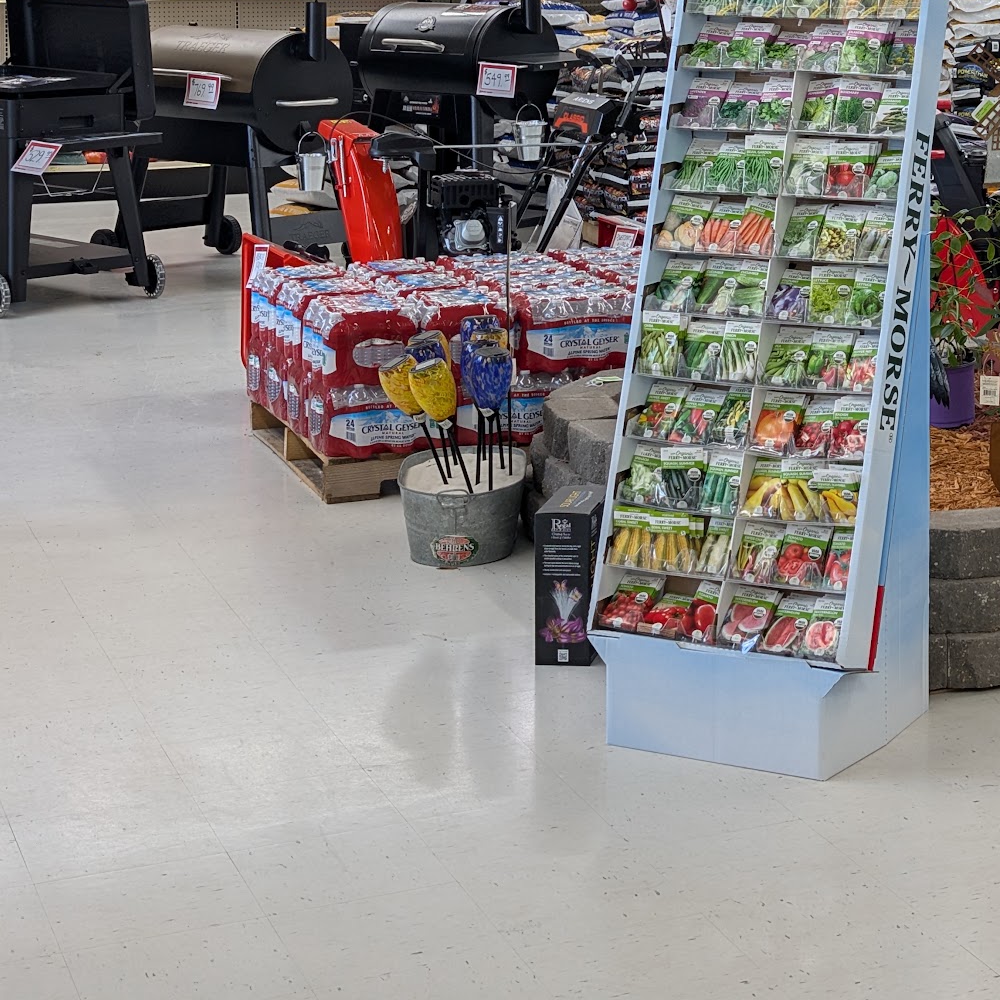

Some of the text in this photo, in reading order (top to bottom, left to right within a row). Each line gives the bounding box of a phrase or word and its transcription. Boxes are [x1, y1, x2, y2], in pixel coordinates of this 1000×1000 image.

[174, 40, 232, 54] TRAEGER
[544, 334, 553, 343] 24
[560, 336, 619, 348] CRYSTAL GEYSER
[524, 410, 542, 419] GEYSE
[346, 420, 355, 428] 24
[362, 422, 421, 435] CRYSTAL GEYSE
[435, 542, 475, 552] BEHRENS
